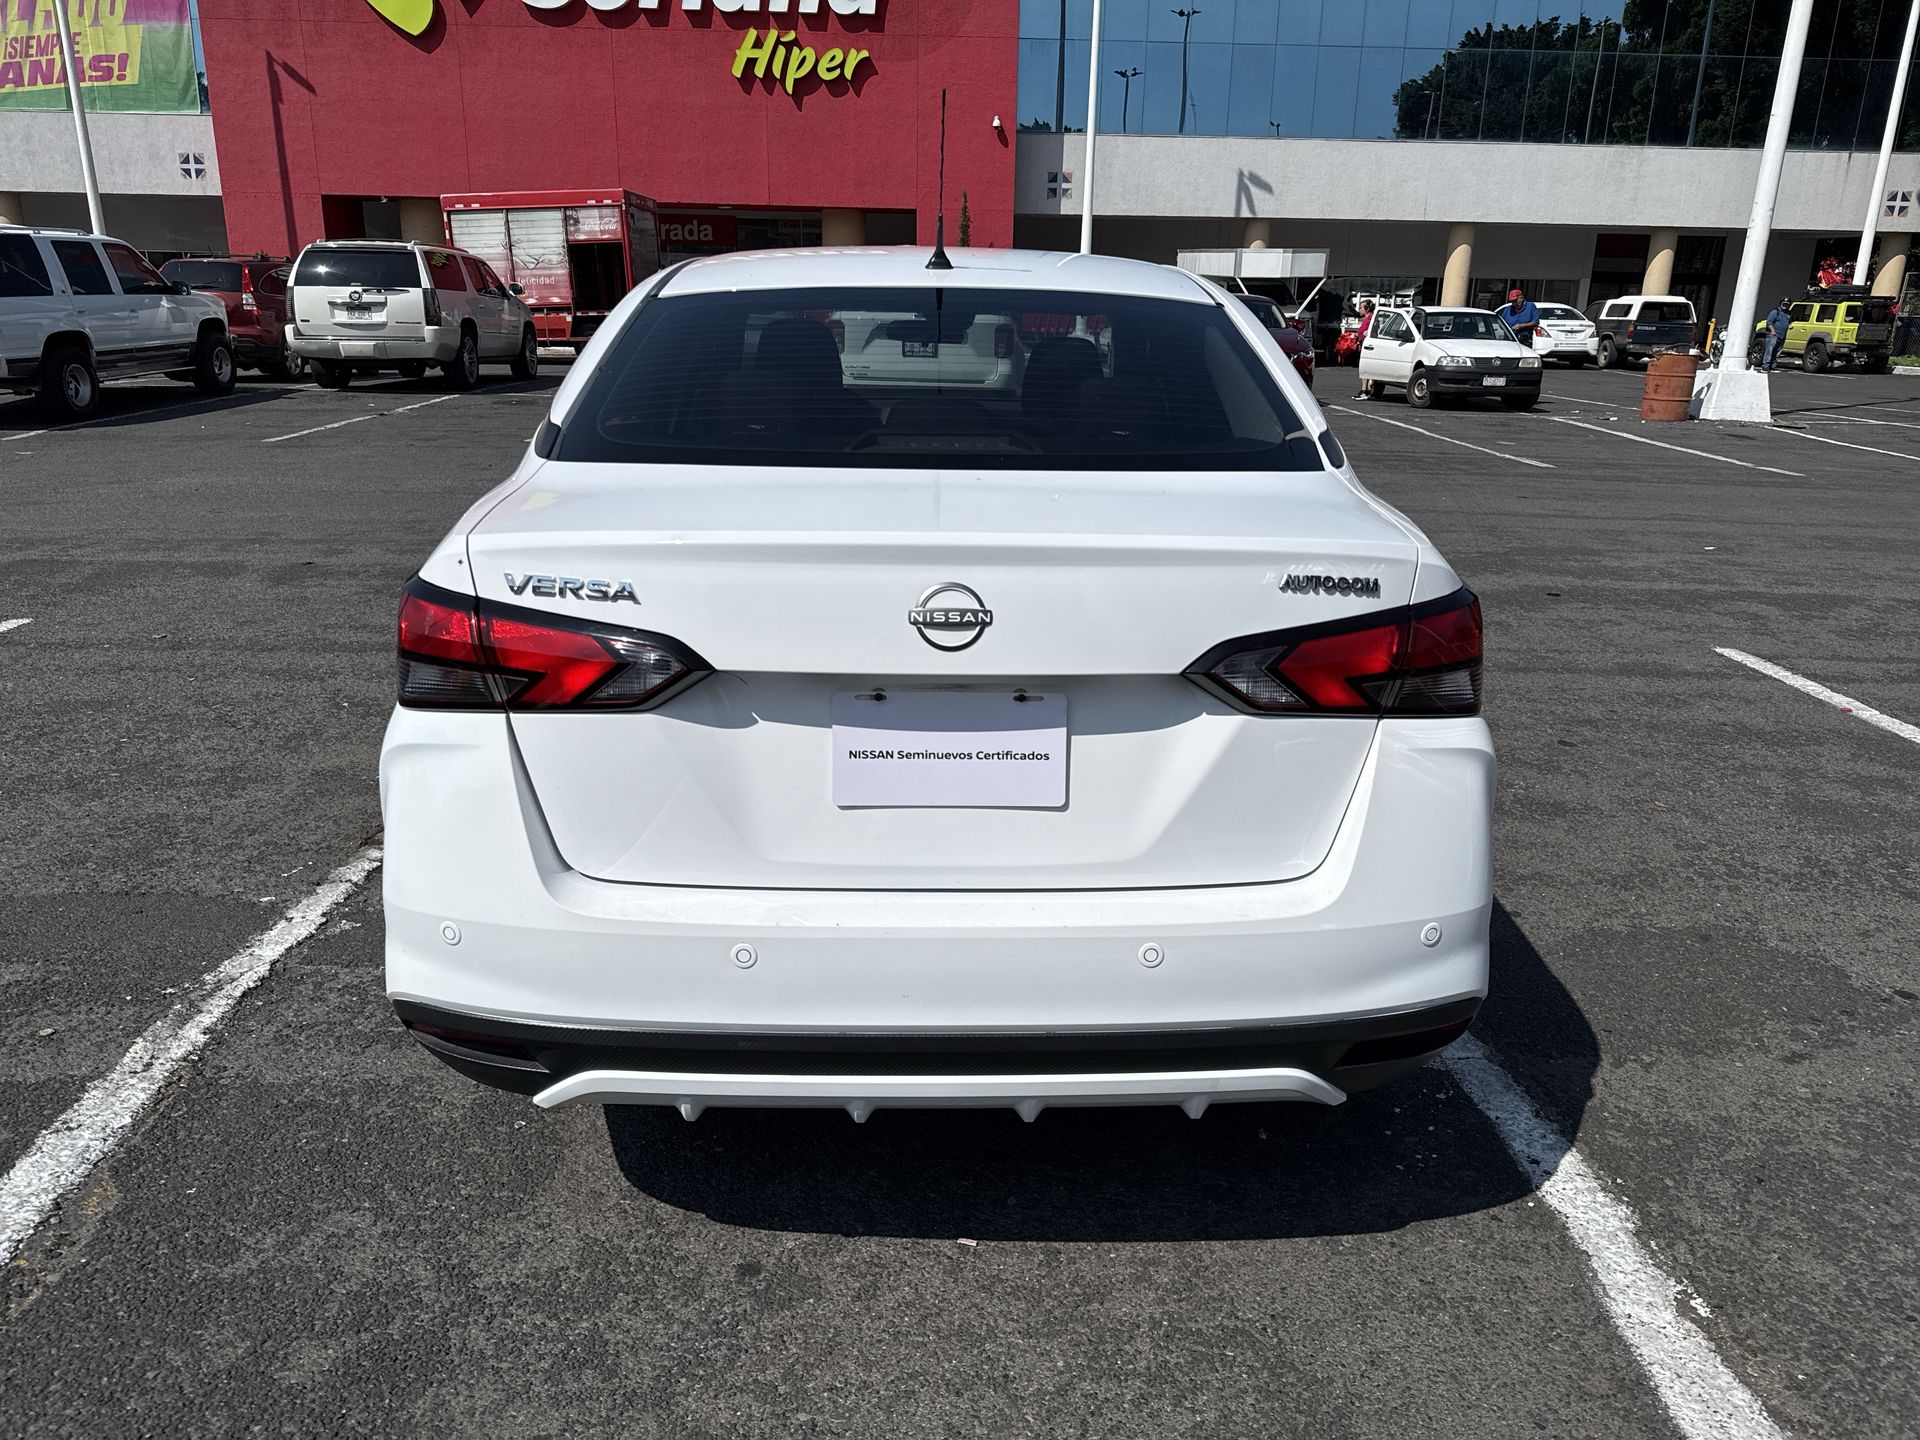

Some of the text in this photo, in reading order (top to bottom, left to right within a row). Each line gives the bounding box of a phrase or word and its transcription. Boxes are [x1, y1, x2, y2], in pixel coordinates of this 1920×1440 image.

[3, 31, 82, 60] ¡SIEMPE
[731, 26, 870, 95] Híper
[517, 275, 555, 286] felicidad
[503, 572, 642, 606] VERSA
[1279, 573, 1381, 597] AUTOCOM
[910, 611, 991, 623] NISSAN
[848, 750, 1050, 761] NISSAN Seminuevos Certificados
